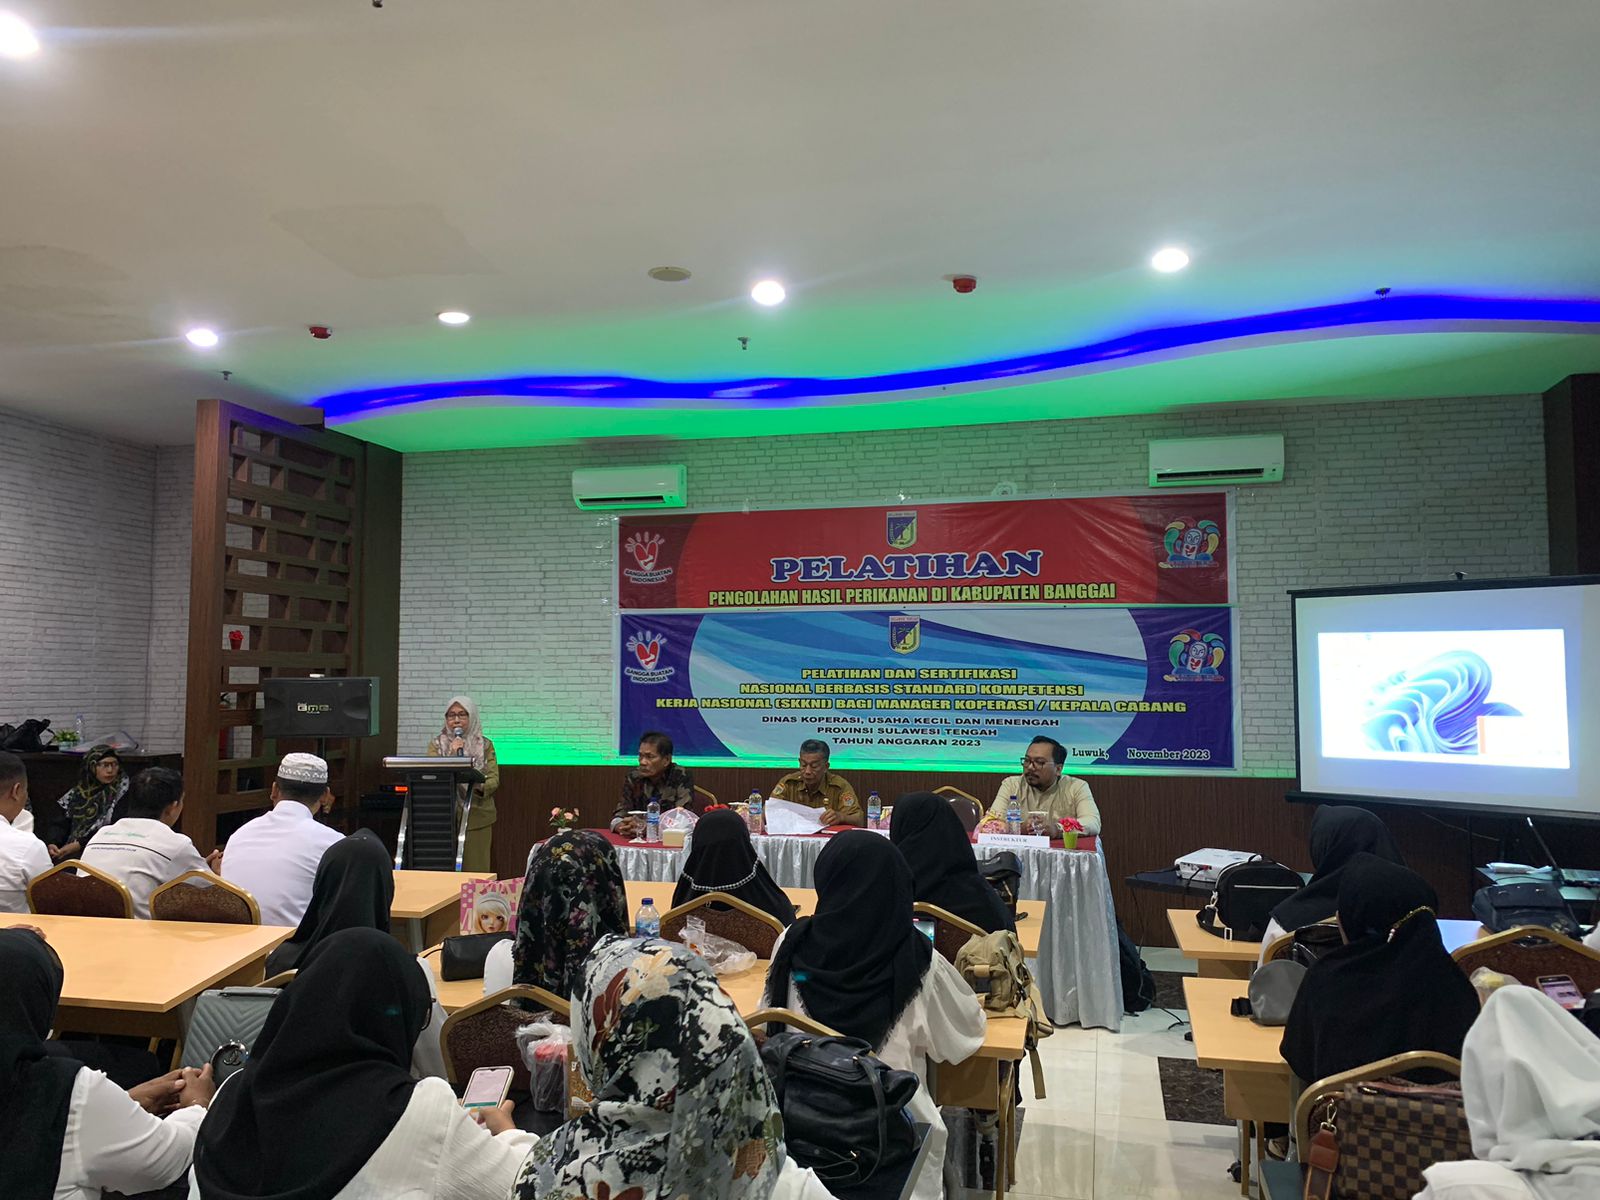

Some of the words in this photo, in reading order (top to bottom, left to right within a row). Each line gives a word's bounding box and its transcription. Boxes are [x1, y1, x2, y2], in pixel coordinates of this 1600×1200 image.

[770, 550, 1042, 582] PELATIHAN
[708, 588, 799, 606] PENGOLAHAN
[801, 588, 843, 606] HASIL
[845, 586, 928, 605] PERIKANAN
[931, 585, 948, 602] DI
[951, 584, 1041, 602] KABUPATEN
[1043, 583, 1117, 600] BANGGAI
[650, 668, 674, 677] BUATAN
[801, 668, 881, 680] PELATIHAN
[883, 668, 916, 680] DAN
[919, 668, 1018, 680] SERTIFIKASI
[739, 683, 812, 695] NASIONAL
[815, 683, 891, 695] BERBASIS
[893, 683, 977, 696] STANDARD
[979, 684, 1085, 697] KOMPETENSI
[655, 698, 699, 709] KERJA
[700, 698, 773, 710] NASIONAL
[774, 698, 833, 710] (SKKNI)
[835, 699, 873, 710] BAGI
[875, 699, 951, 710] MANAGER
[954, 699, 1034, 712] KOPERASI
[1036, 700, 1048, 712] /
[1049, 700, 1113, 713] KEPALA
[1114, 701, 1188, 713] CABANG
[761, 716, 798, 724] DINAS
[800, 716, 865, 725] KOPERASI,
[867, 717, 911, 725] USAHA
[913, 717, 951, 725] KECIL
[954, 717, 982, 726] DAN
[984, 718, 1060, 727] MENENGAH
[816, 726, 874, 735] PROVINSI
[877, 727, 941, 735] SULAWESI
[945, 728, 997, 736] TENGAH
[877, 738, 947, 746] ANGGARAN
[1071, 747, 1110, 760] Luwuk,
[1127, 748, 1181, 760] November
[1182, 748, 1210, 760] 2023
